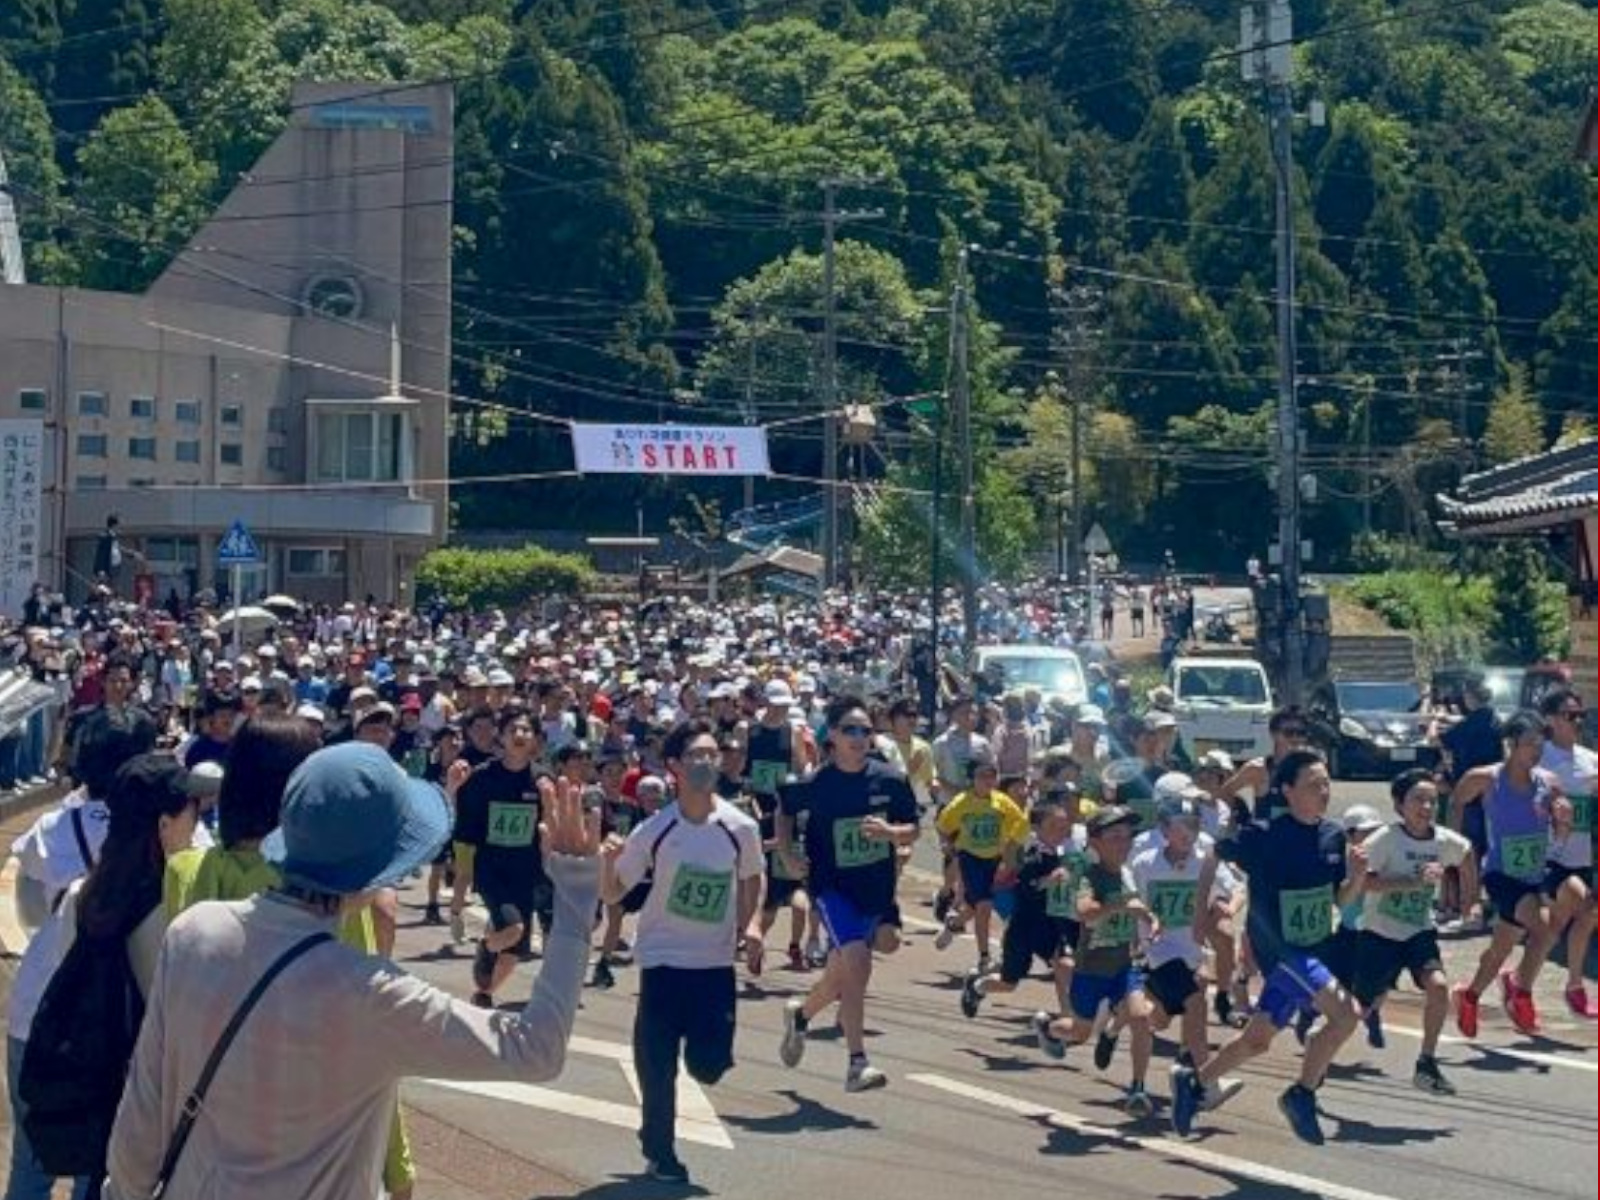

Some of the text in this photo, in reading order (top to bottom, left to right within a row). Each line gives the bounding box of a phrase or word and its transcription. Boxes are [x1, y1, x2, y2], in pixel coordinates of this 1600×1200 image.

[641, 443, 737, 469] START
[494, 813, 530, 836] 461
[677, 880, 729, 913] 497
[1153, 890, 1195, 917] 476
